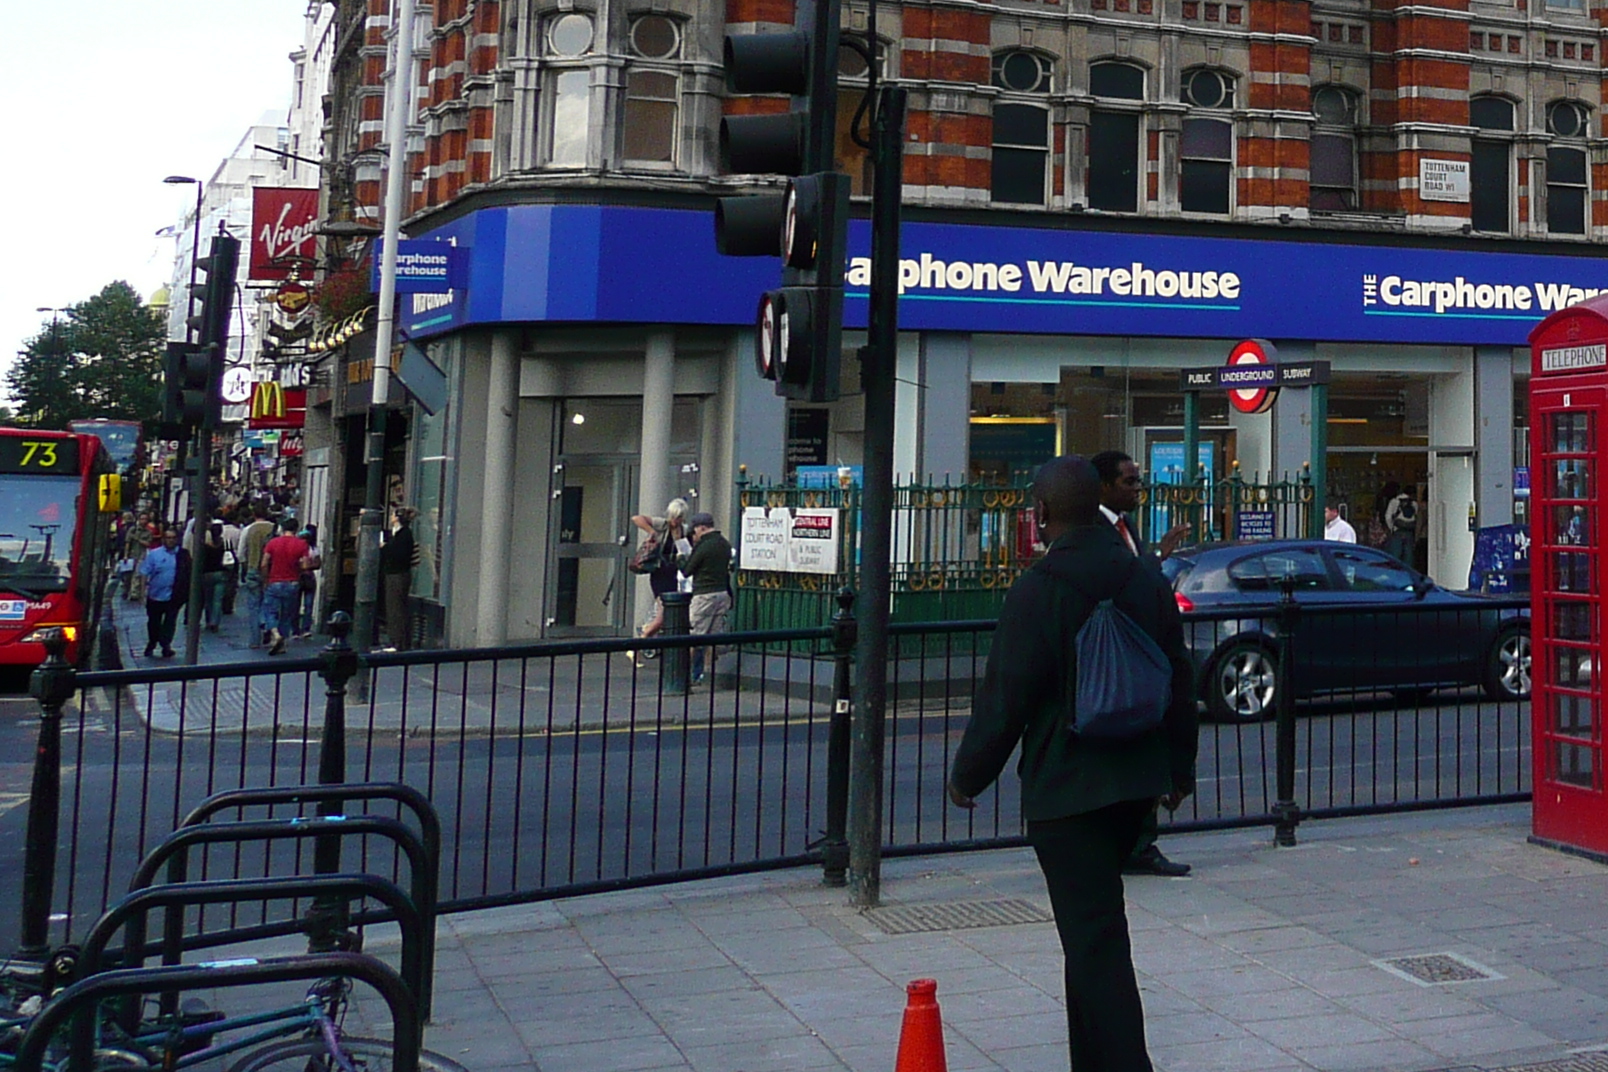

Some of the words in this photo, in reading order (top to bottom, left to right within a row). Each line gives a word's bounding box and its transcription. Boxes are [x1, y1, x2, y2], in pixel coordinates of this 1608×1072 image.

[1424, 162, 1466, 173] TOTTENHAM
[1424, 172, 1447, 182] COURT
[1424, 182, 1444, 191] ROAD
[844, 253, 1021, 295] aphone
[1026, 260, 1241, 299] Warehouse
[1364, 274, 1377, 306] THE
[1380, 275, 1532, 314] Carphone
[1545, 347, 1605, 369] TELEPHONE
[1188, 373, 1212, 384] PUBLIC
[1220, 370, 1275, 383] UNDERGROUND
[1282, 367, 1312, 379] SUBWAY
[20, 442, 58, 467] 73
